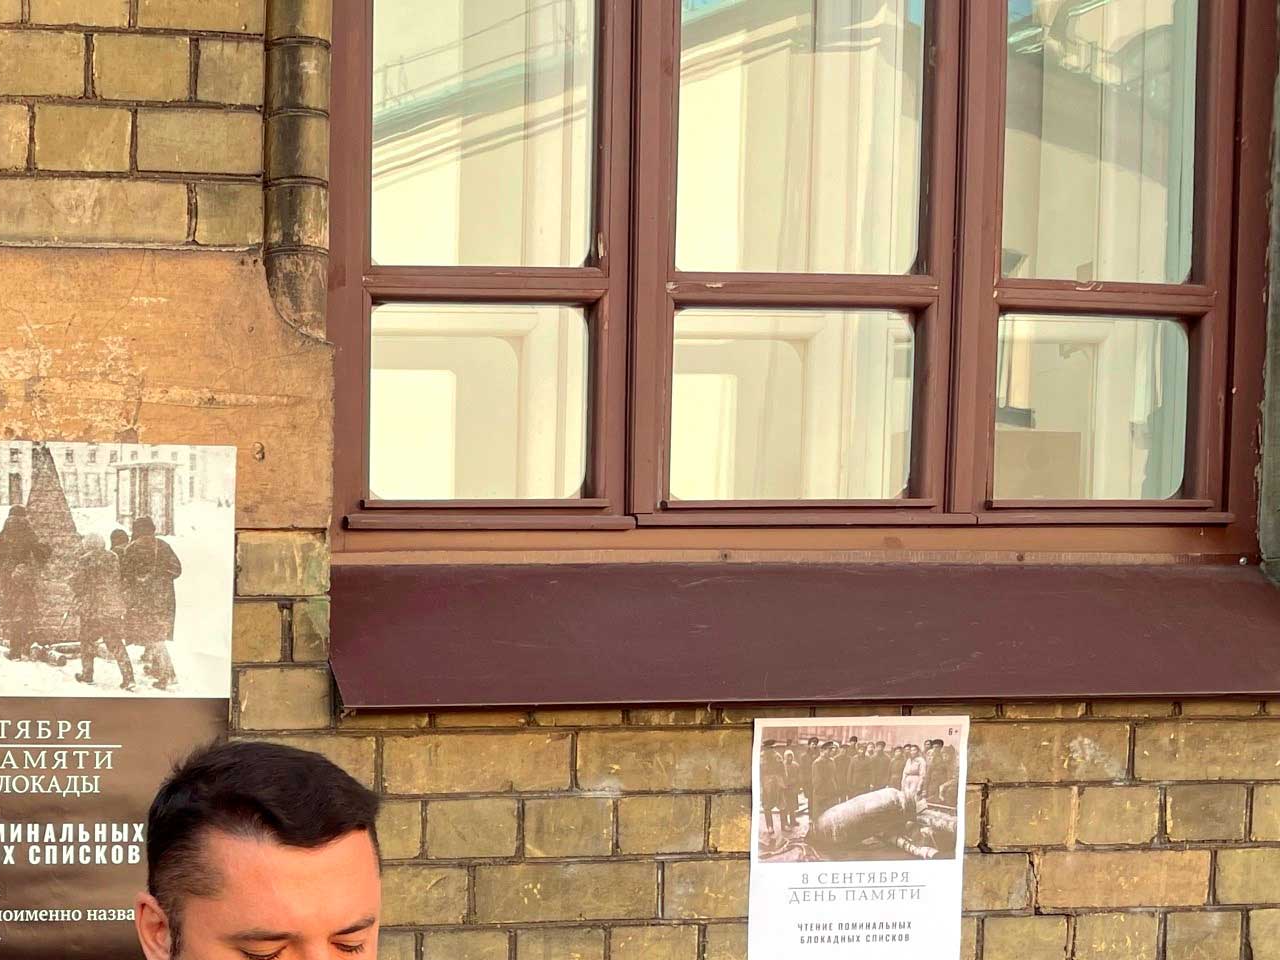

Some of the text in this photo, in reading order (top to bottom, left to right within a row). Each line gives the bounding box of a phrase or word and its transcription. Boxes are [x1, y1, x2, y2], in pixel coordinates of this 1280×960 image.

[29, 845, 141, 864] СПИСКОВ
[802, 872, 910, 884] 8 СЕНТЯБРЯ
[789, 889, 921, 904] ДЕНЬ ПАМЯТИ
[87, 907, 136, 921] назва
[797, 921, 912, 932] ЧТЕНИЕ ПОМИНАЛЬНЫХ
[800, 934, 910, 944] БЛОКАДНЫХ СПИСКОВ
